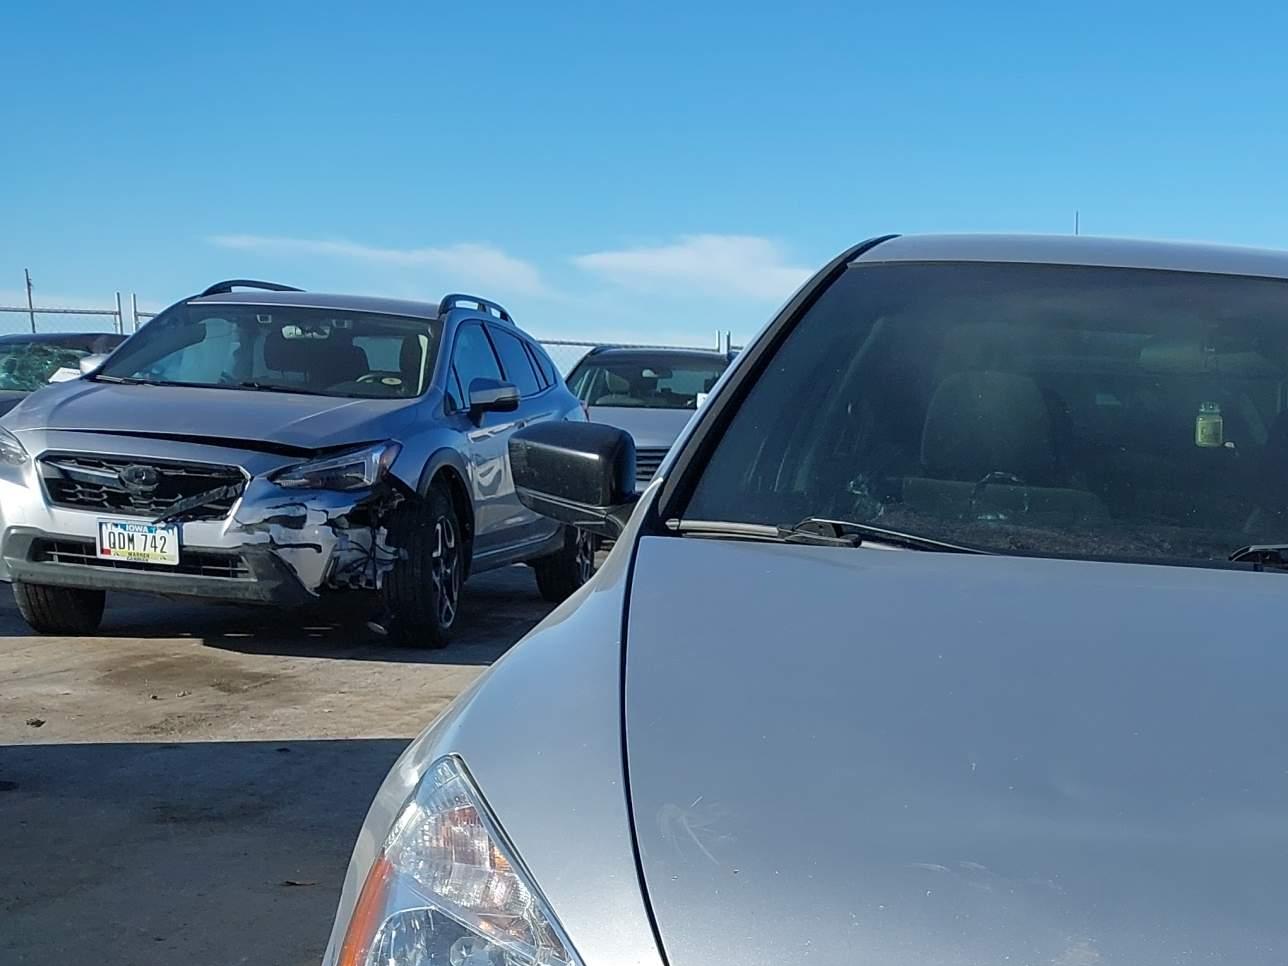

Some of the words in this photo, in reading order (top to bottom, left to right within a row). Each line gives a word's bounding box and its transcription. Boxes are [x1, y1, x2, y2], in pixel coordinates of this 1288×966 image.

[126, 524, 148, 533] IOWA
[108, 531, 135, 551] QDM
[141, 534, 168, 554] 742
